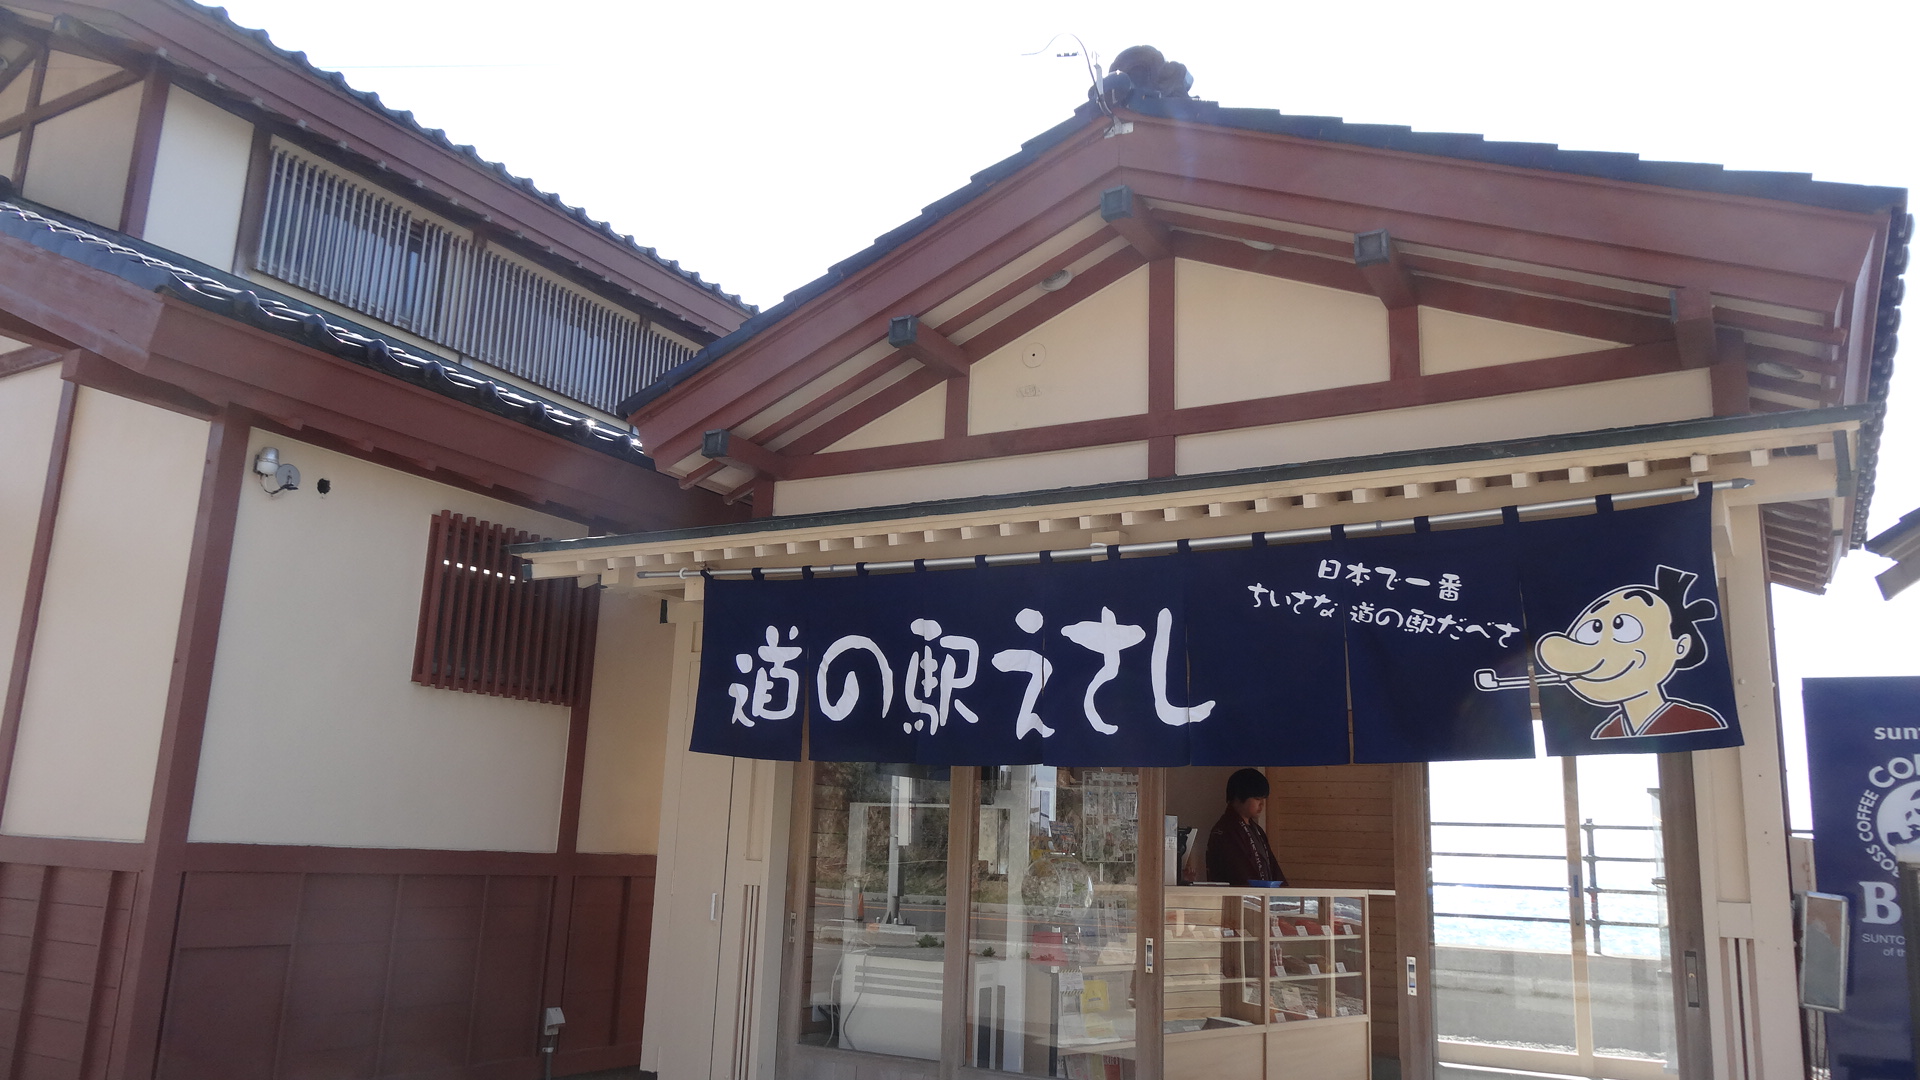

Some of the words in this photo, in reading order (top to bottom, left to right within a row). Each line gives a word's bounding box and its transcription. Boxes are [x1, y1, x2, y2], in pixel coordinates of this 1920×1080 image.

[1317, 559, 1463, 602] 日本で一番
[1247, 582, 1339, 618] ちいさな
[1349, 601, 1521, 649] 道の駅だべさ
[728, 606, 1216, 740] 道の駅えさし
[1856, 789, 1880, 842] COFFEE
